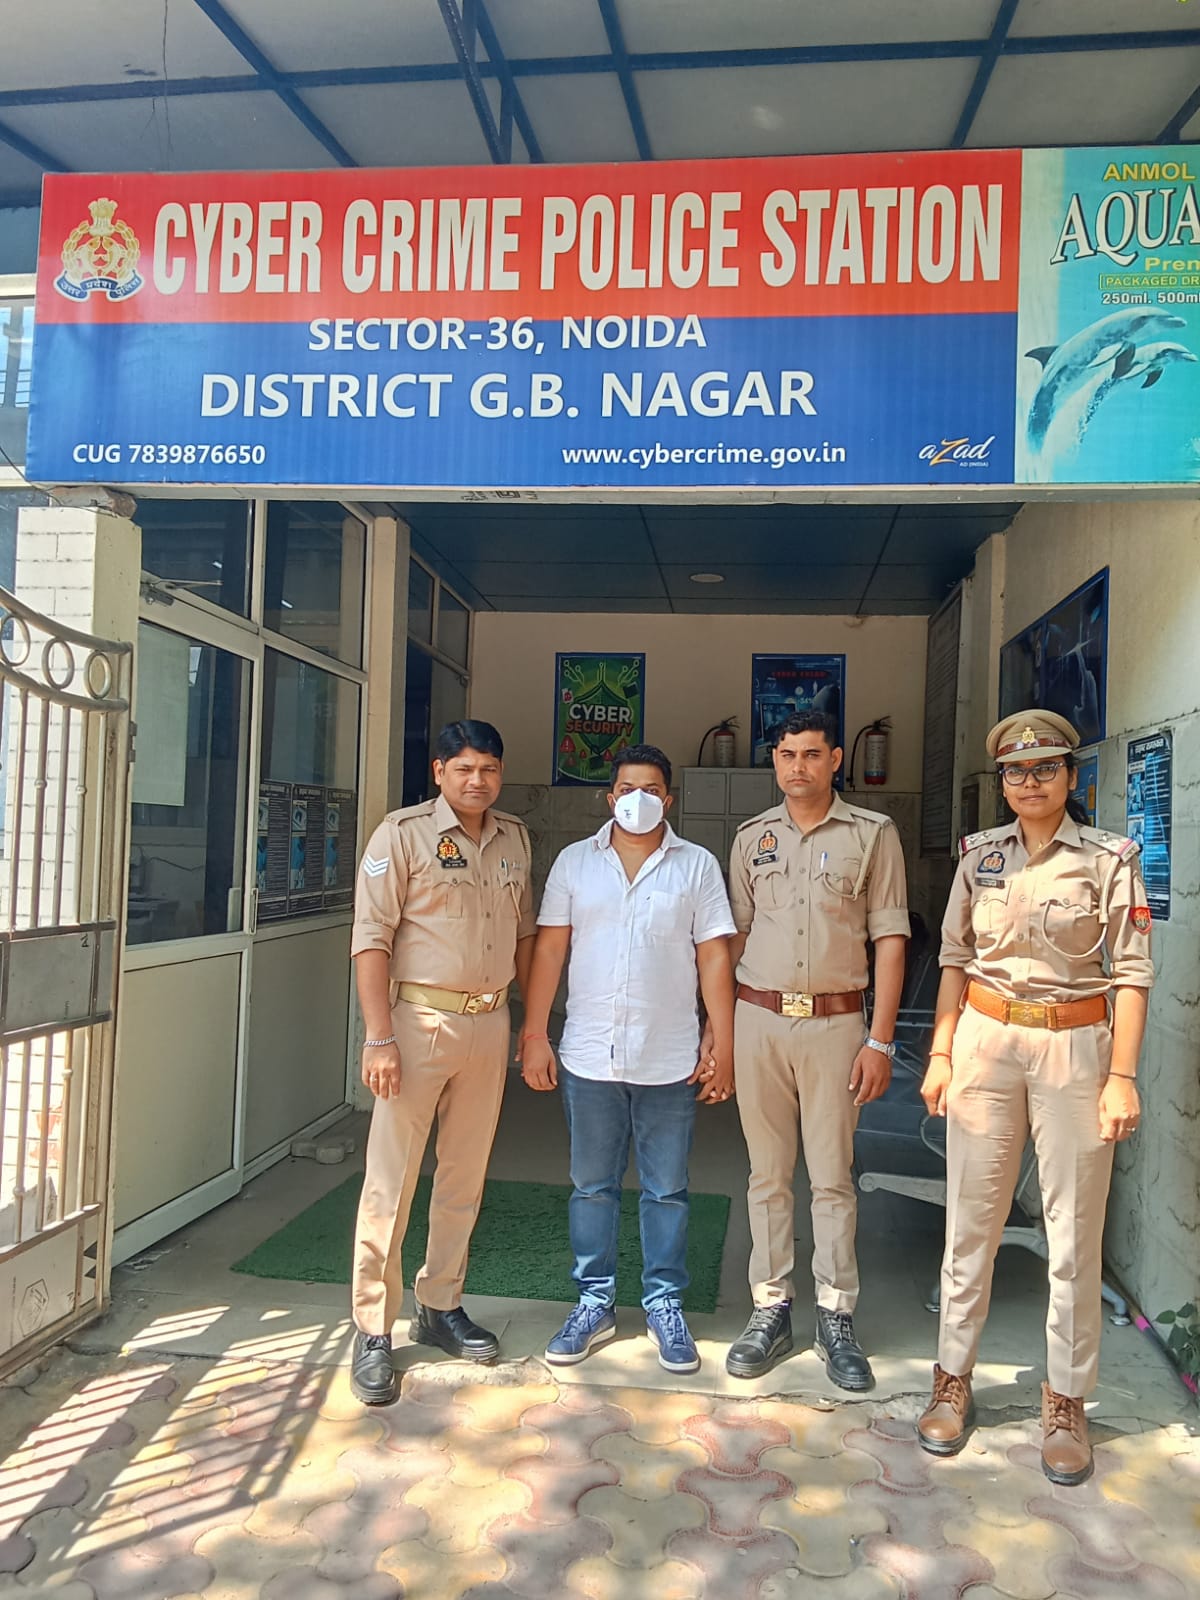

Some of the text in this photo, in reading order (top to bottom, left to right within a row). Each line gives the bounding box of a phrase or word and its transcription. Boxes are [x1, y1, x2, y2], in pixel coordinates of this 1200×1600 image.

[1103, 162, 1196, 182] ANMOL
[152, 184, 1003, 296] CYBER CRIME POLICE STATION
[1106, 276, 1177, 287] PACKAGED
[308, 314, 707, 355] SECTOR-36, NOIDA
[200, 370, 818, 419] DISTRICT G.B. NAGAR
[72, 443, 266, 466] CUG 7839876650
[561, 441, 847, 468] www.cybercrime.gov.in
[569, 703, 631, 722] CYBER
[566, 720, 633, 736] SECURITY
